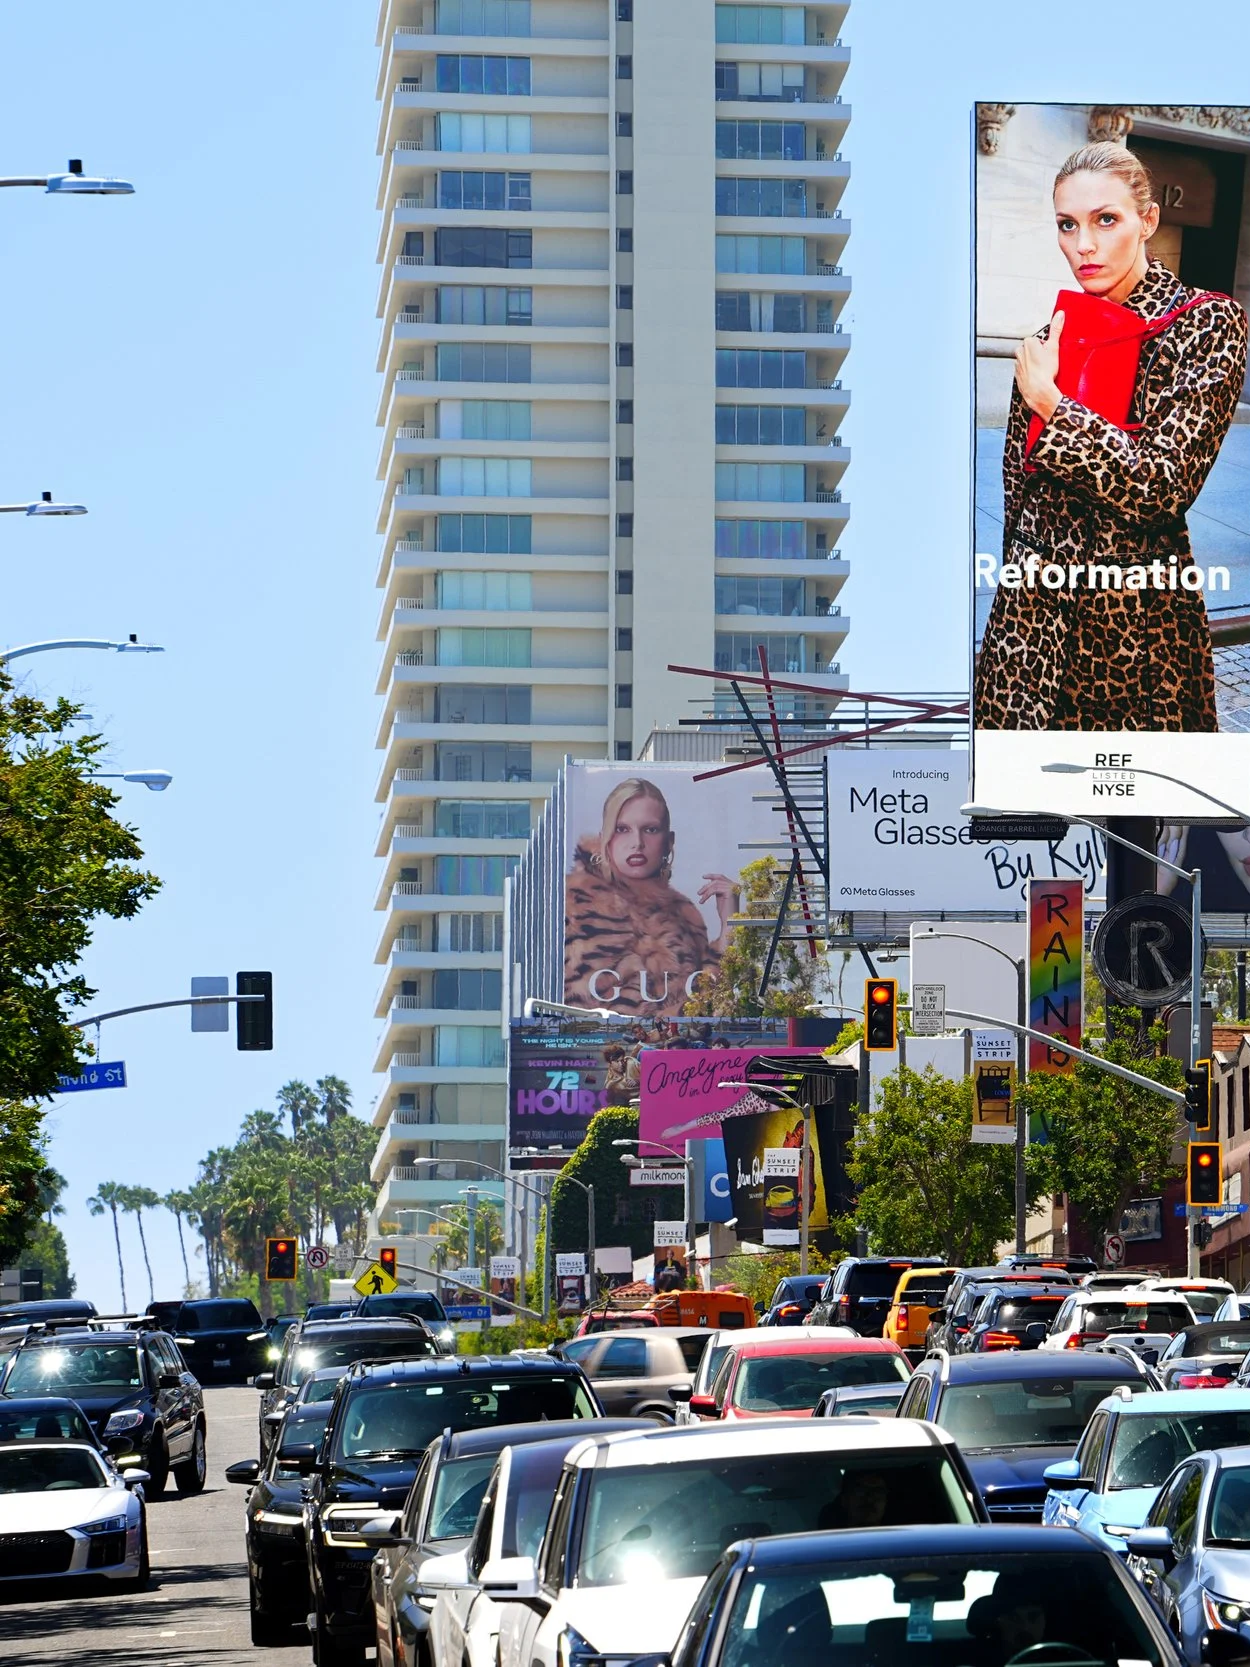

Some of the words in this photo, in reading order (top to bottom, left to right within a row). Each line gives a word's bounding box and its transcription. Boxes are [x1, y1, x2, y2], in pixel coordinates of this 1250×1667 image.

[974, 552, 1231, 591] Reformation
[1095, 753, 1132, 767] REF
[892, 769, 949, 781] Introducing
[1092, 772, 1135, 780] LISTED
[1092, 783, 1135, 797] NYSE
[850, 787, 929, 814] Meta
[874, 817, 992, 846] Glasse
[984, 846, 1035, 890] By
[1047, 827, 1108, 894] Kyl
[853, 887, 878, 896] Meta
[878, 887, 915, 896] Glasses
[589, 969, 717, 1002] GUC
[528, 1059, 562, 1068] KEVIN
[565, 1059, 598, 1068] HART
[104, 1067, 123, 1082] St
[545, 1070, 580, 1090] 72
